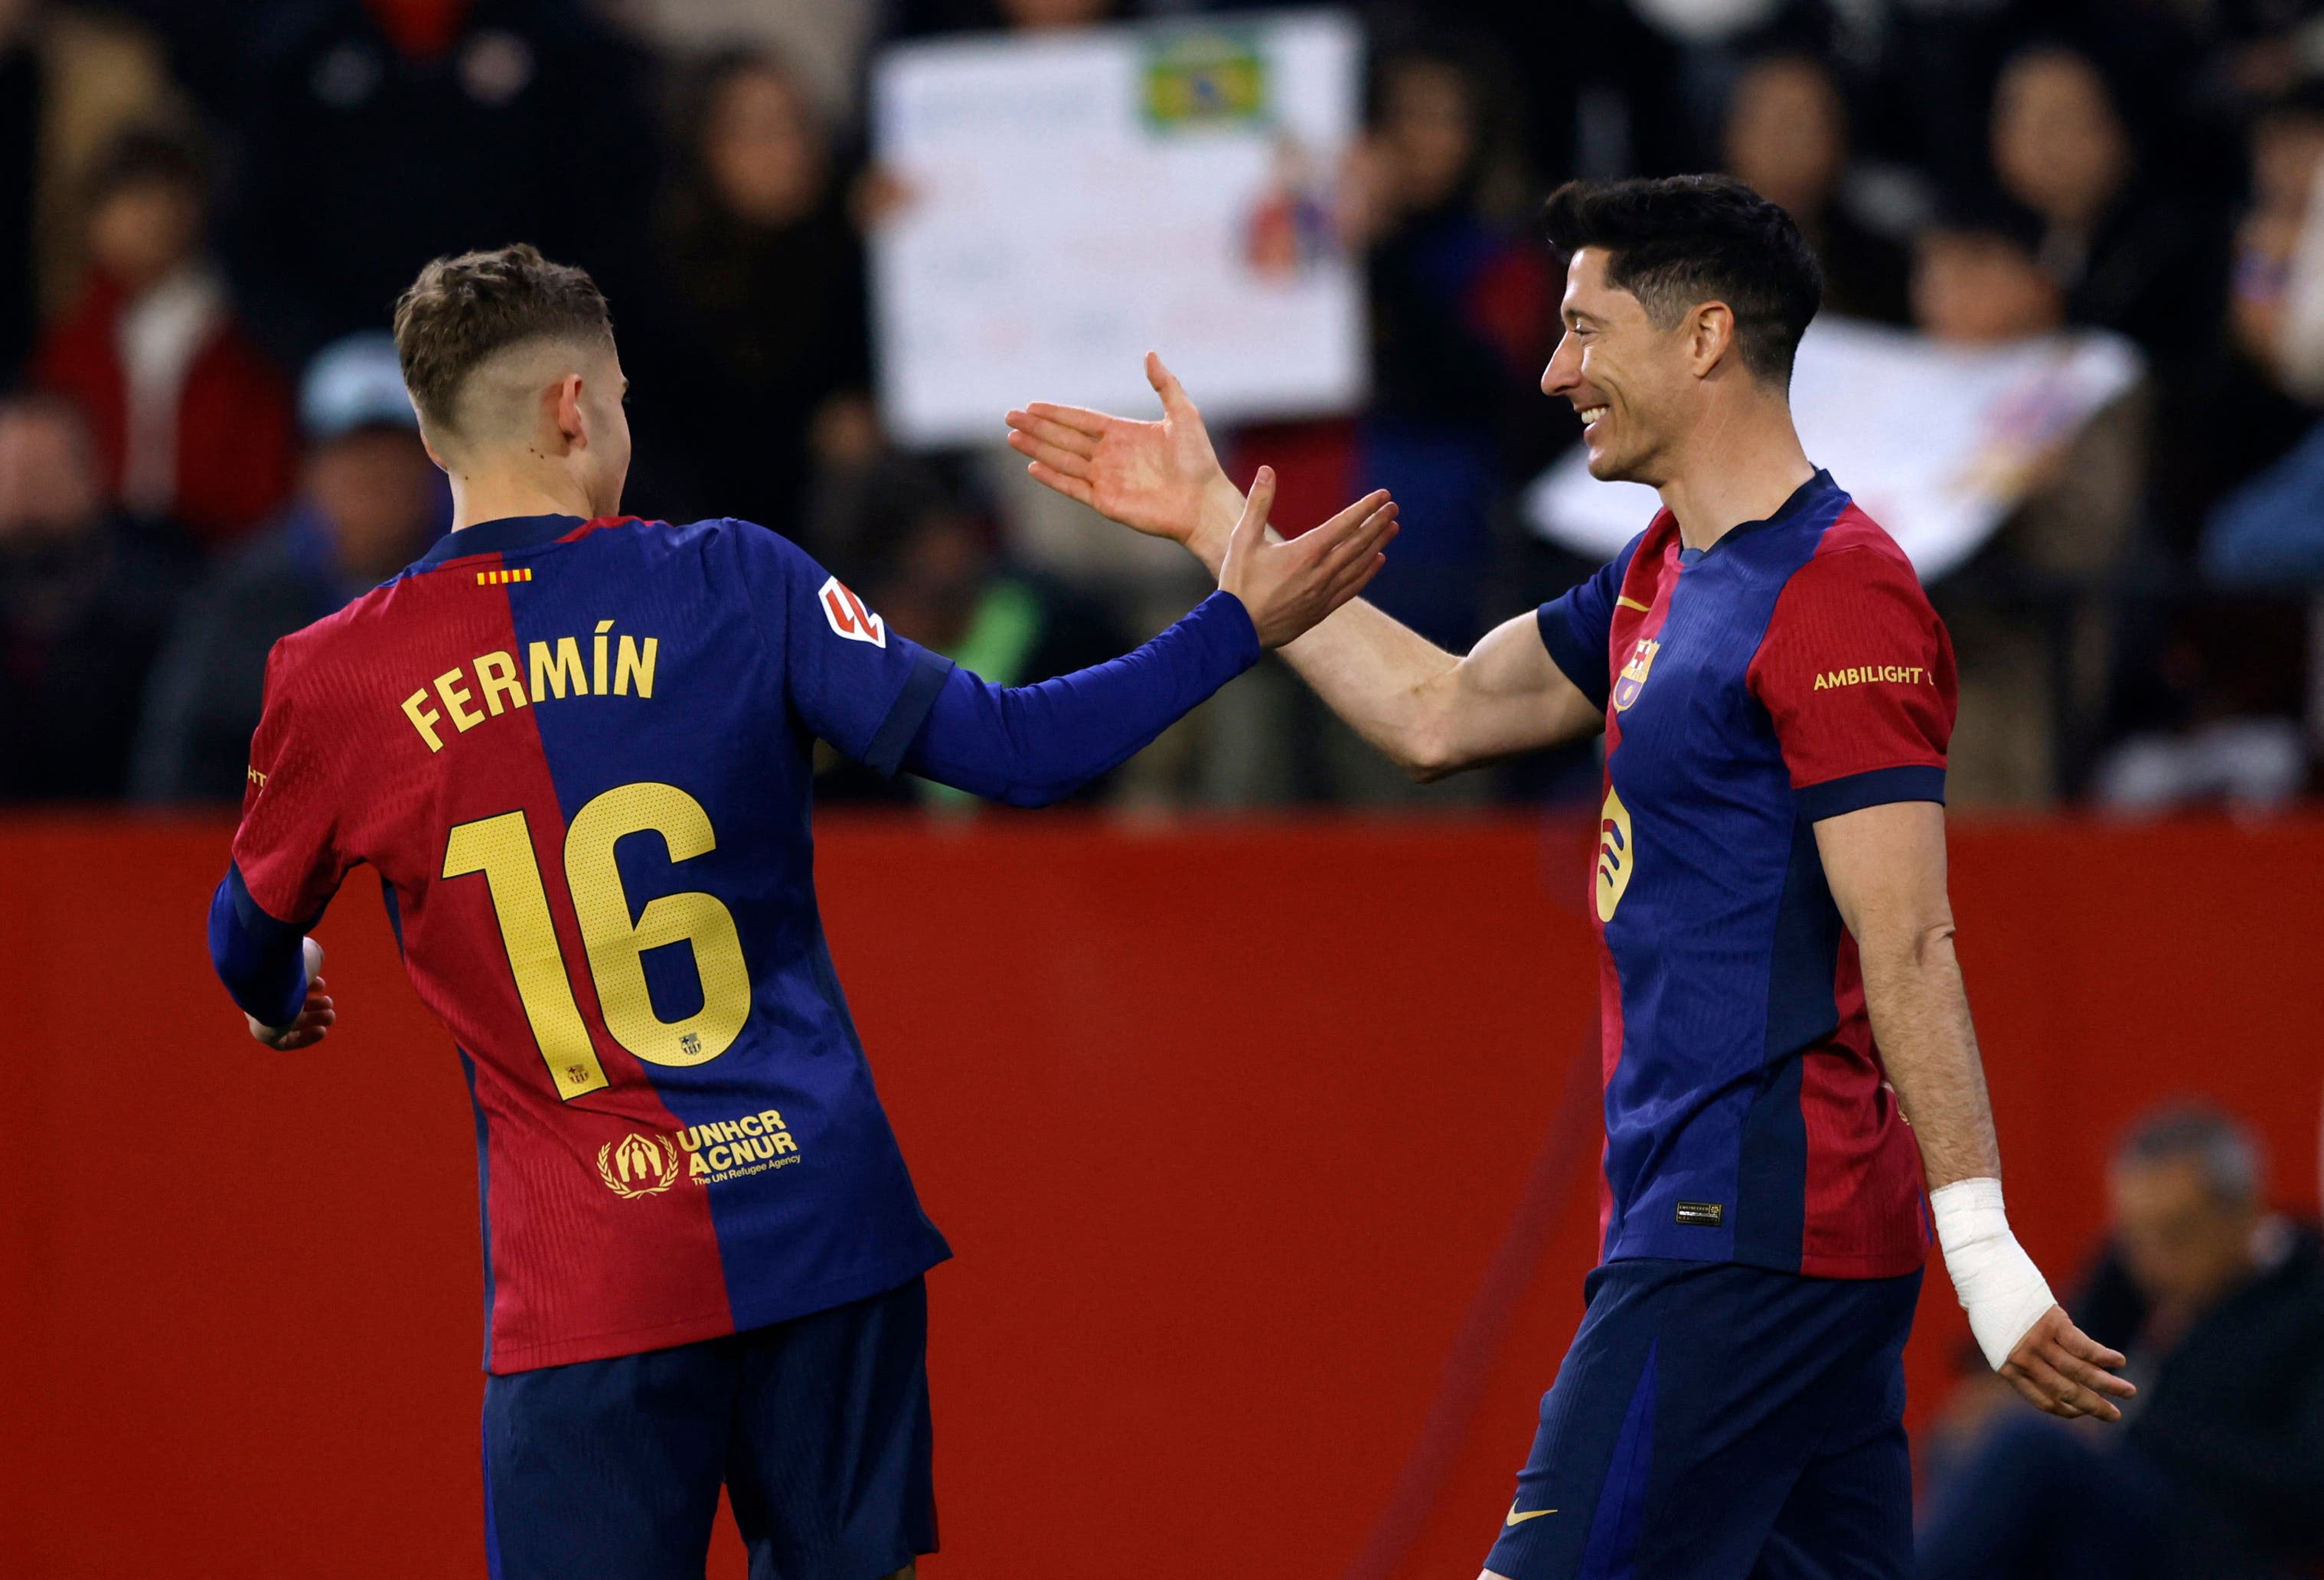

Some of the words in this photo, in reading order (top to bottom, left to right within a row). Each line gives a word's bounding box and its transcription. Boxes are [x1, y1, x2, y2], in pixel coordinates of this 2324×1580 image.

[400, 619, 658, 753] FERMÍN
[1813, 665, 1923, 690] AMBILIGHT
[441, 782, 752, 1102] 16
[676, 1109, 786, 1152] UNHCR
[689, 1131, 798, 1177] ACNUR
[692, 1177, 711, 1186] The
[712, 1172, 728, 1183] UN
[729, 1163, 767, 1179] Refugee
[769, 1154, 801, 1169] Agency
